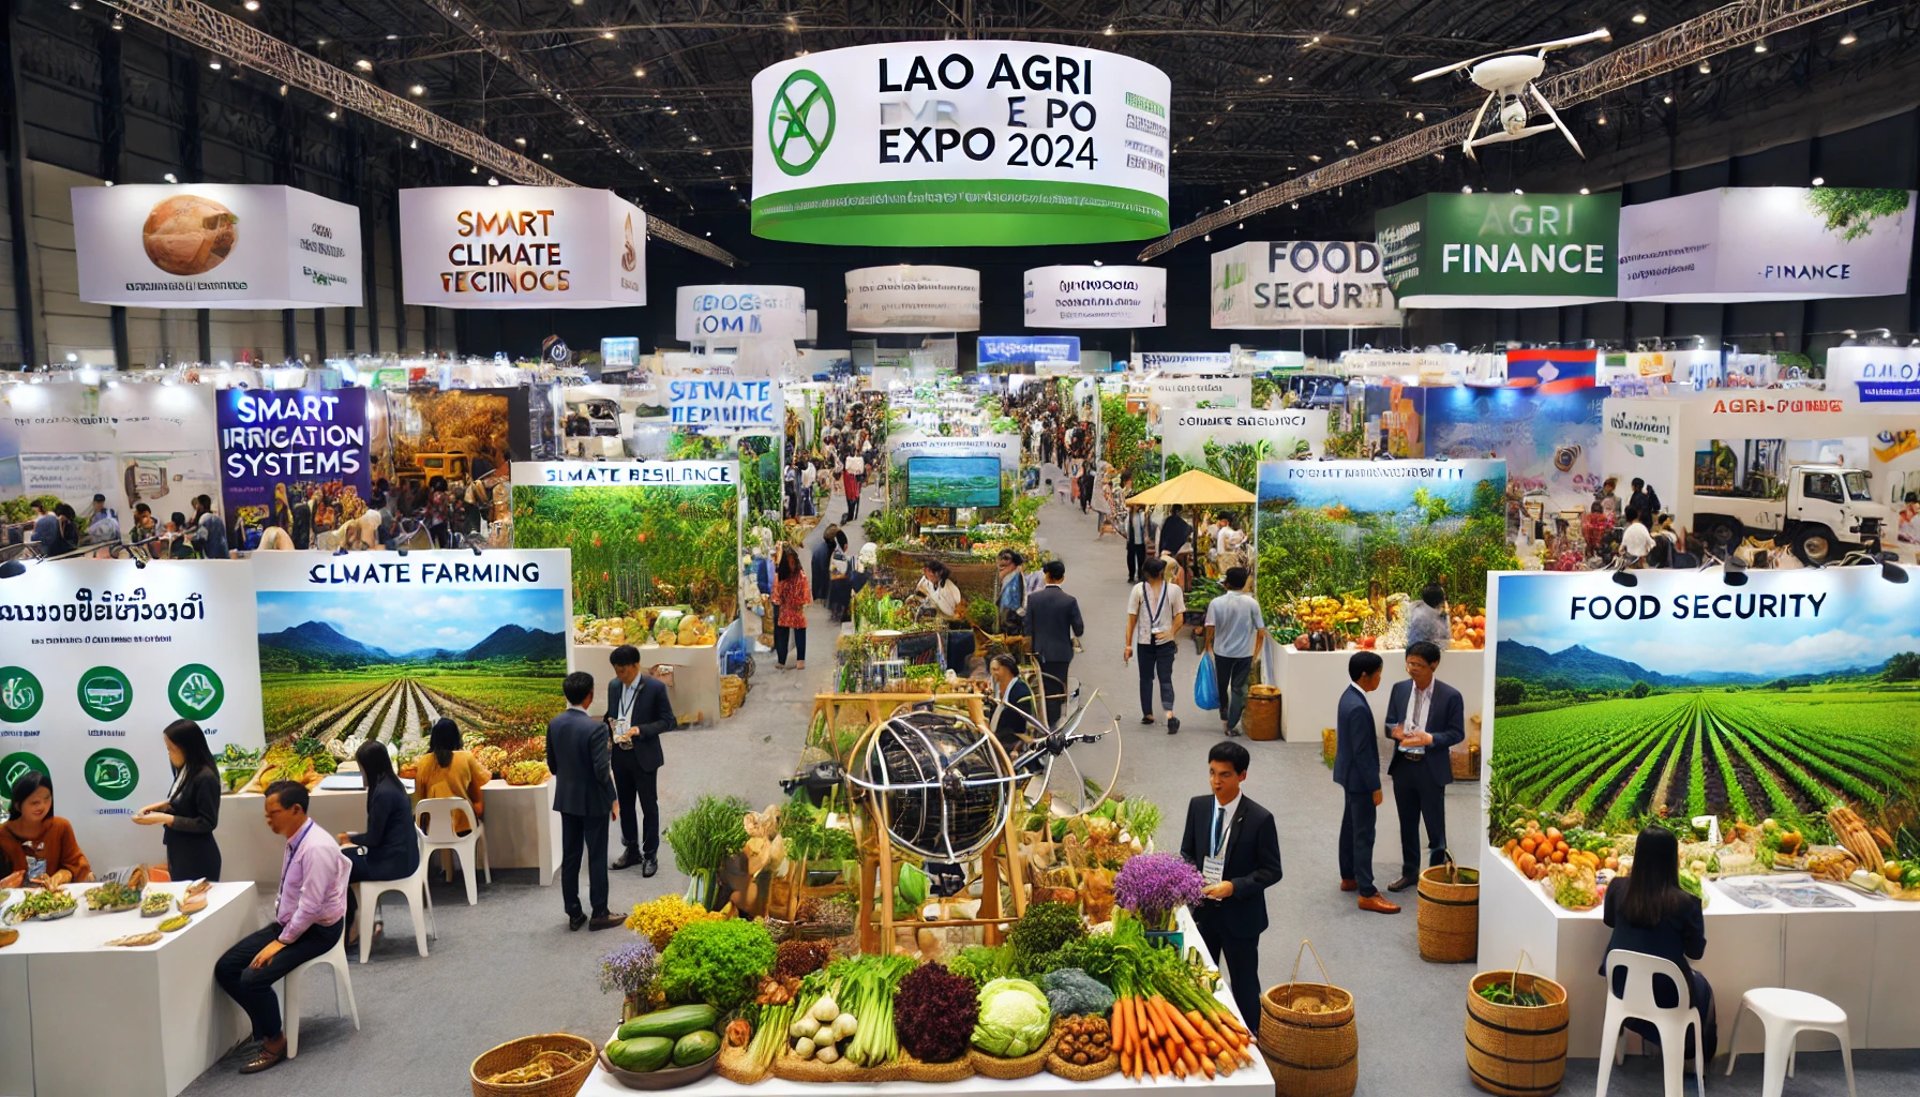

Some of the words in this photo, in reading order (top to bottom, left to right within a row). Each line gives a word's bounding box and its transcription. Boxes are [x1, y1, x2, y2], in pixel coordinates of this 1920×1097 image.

[879, 53, 974, 93] LAO
[987, 53, 1092, 95] AGRI
[879, 127, 996, 164] EXPO
[1006, 132, 1098, 170] 2024
[457, 209, 555, 237] SMART
[1478, 203, 1575, 236] AGRI
[449, 243, 561, 266] CLIMATE
[1268, 241, 1380, 274] FOOD
[1442, 243, 1604, 274] FINANCE
[237, 395, 340, 423] SMART
[227, 449, 361, 479] SYSTEMS
[421, 562, 540, 584] FARMING
[1570, 594, 1661, 621] FOOD
[1672, 592, 1827, 620] SECURITY
